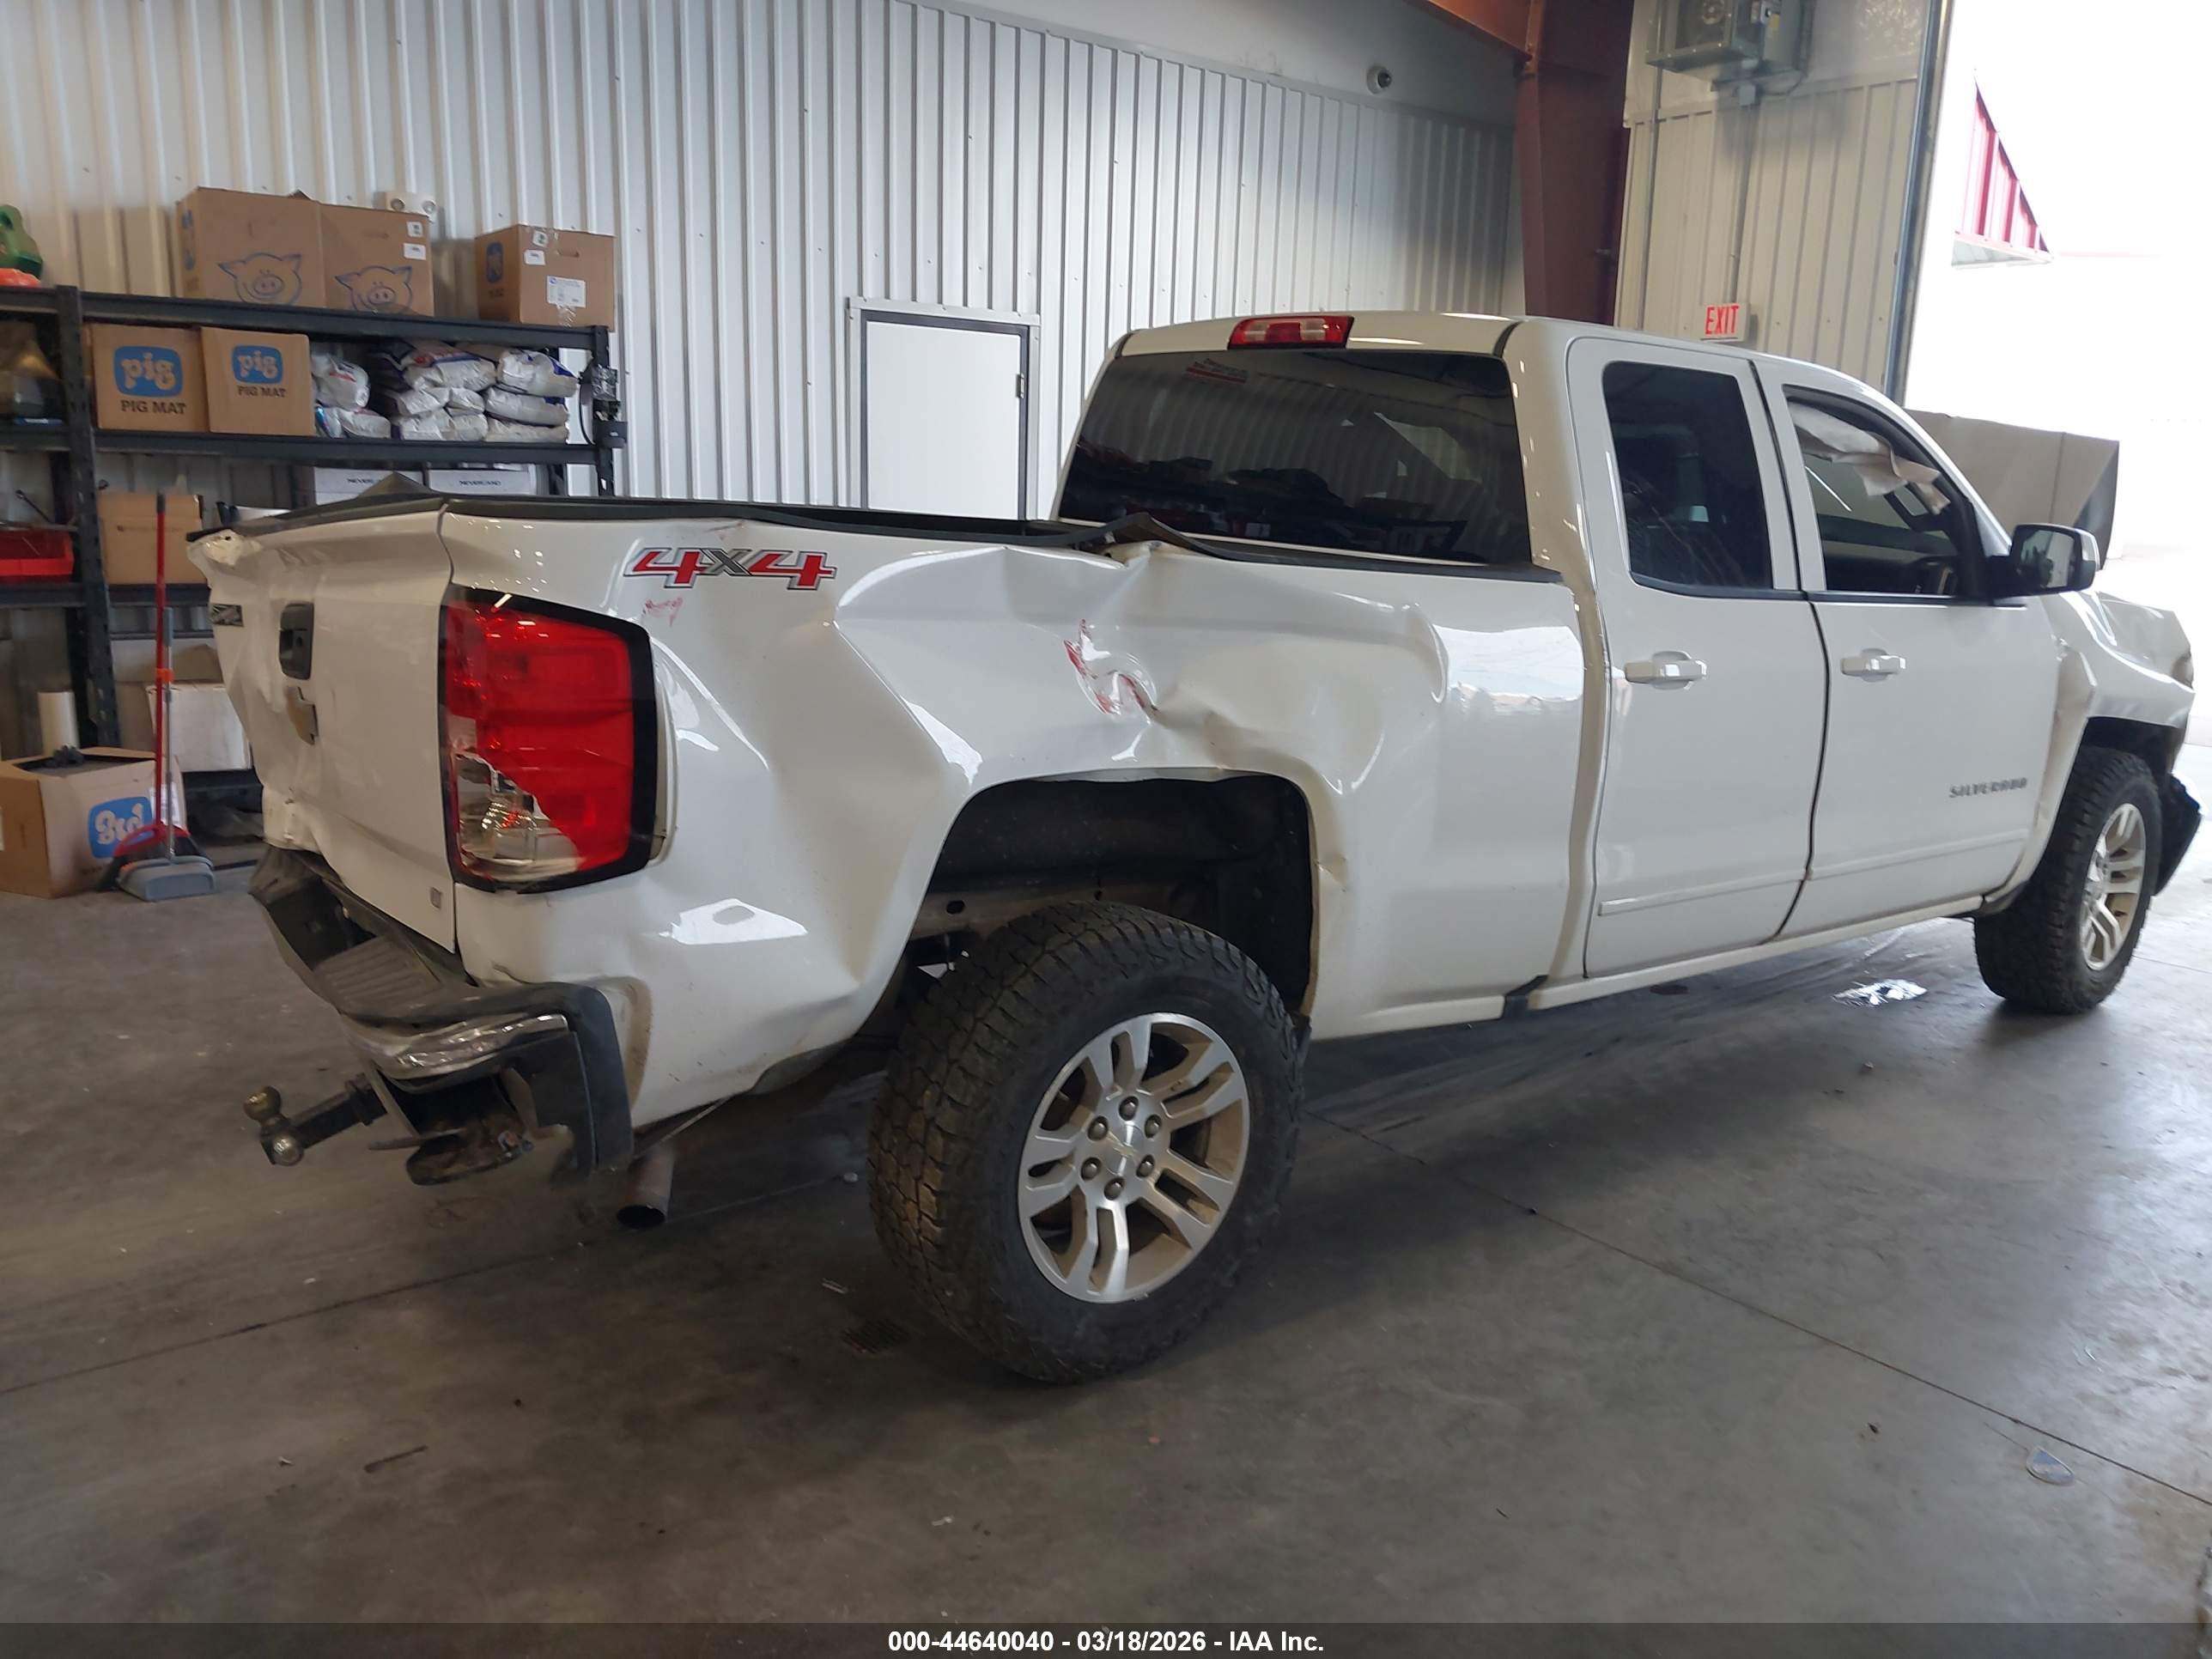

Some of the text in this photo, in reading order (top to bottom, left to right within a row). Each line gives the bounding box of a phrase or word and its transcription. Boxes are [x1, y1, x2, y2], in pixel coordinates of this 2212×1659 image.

[1705, 305, 1739, 335] EXIT
[120, 352, 176, 391] pig
[237, 350, 278, 379] pig
[238, 386, 287, 398] PIG MAT
[120, 399, 186, 415] PIG MAT
[1948, 776, 2027, 798] SILVERADO
